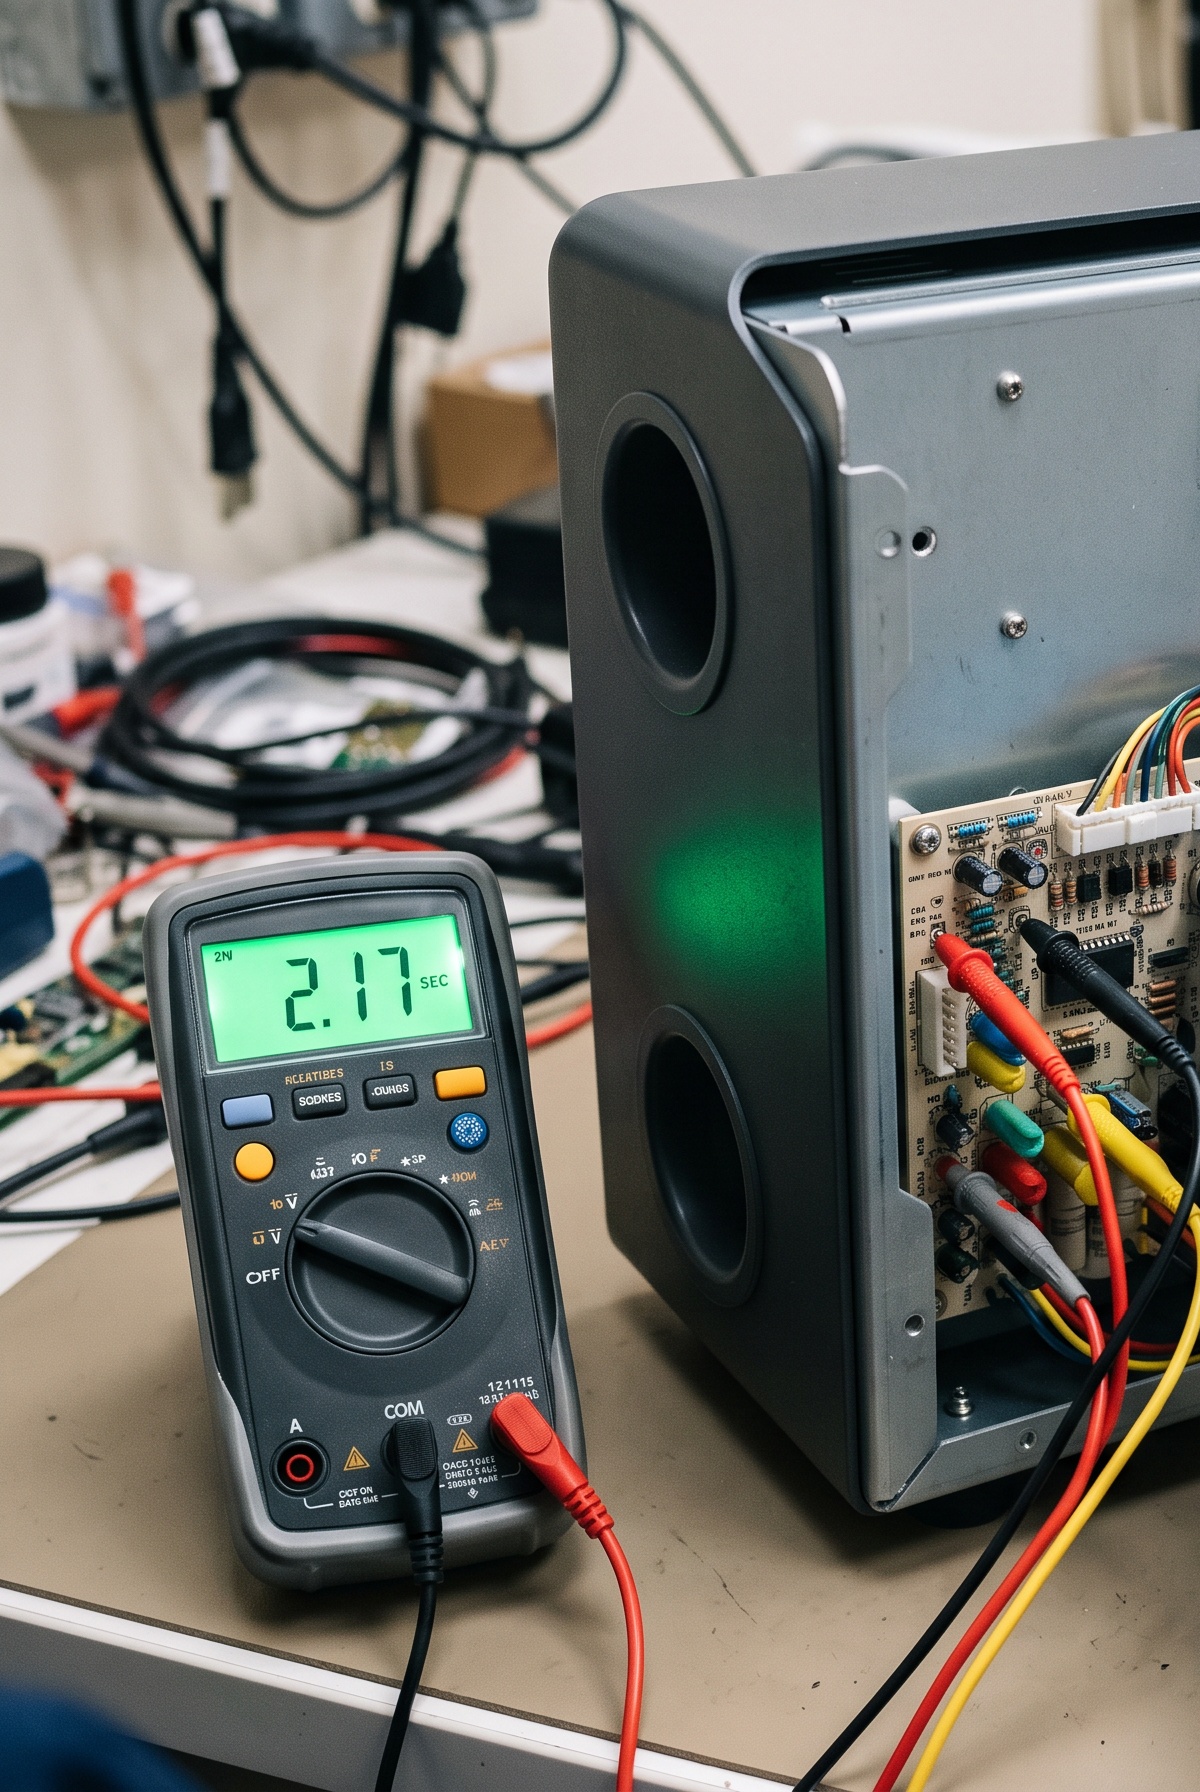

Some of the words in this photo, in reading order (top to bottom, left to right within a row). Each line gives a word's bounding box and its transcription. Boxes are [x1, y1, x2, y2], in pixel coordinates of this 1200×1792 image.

[285, 946, 412, 1031] 2.17
[420, 974, 449, 989] SEC
[246, 1267, 280, 1285] OFF
[488, 1376, 534, 1392] 121115
[384, 1400, 425, 1419] COM
[289, 1418, 304, 1434] A
